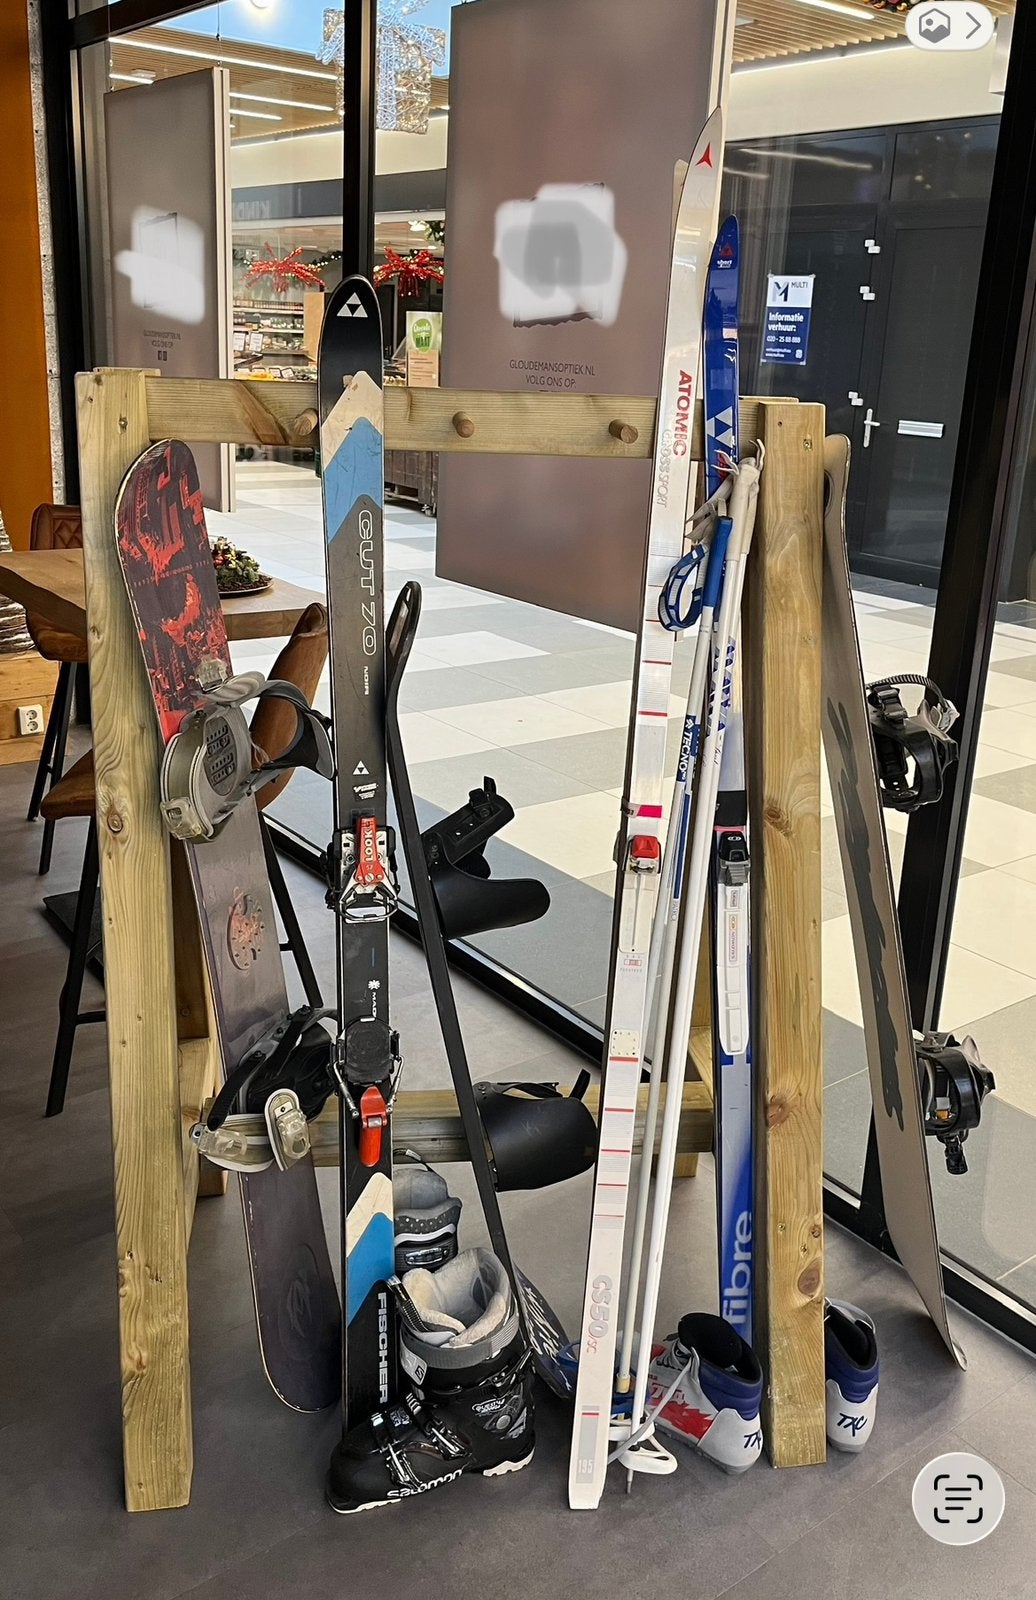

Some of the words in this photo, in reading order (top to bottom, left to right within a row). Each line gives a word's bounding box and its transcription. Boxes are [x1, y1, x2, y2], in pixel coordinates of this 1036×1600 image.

[767, 322, 797, 332] verhuur:
[768, 312, 804, 322] Informatie
[509, 359, 596, 376] GLOUDEMANSOPTIEK.NL
[526, 374, 545, 386] VOLG
[546, 376, 562, 387] ONS
[672, 370, 692, 457] ATOMIC
[358, 509, 375, 596] CUT
[361, 601, 377, 656] 70
[364, 830, 374, 862] LOOK
[722, 1210, 752, 1324] fibre
[378, 1292, 388, 1404] FISCHER
[578, 1459, 594, 1474] 195
